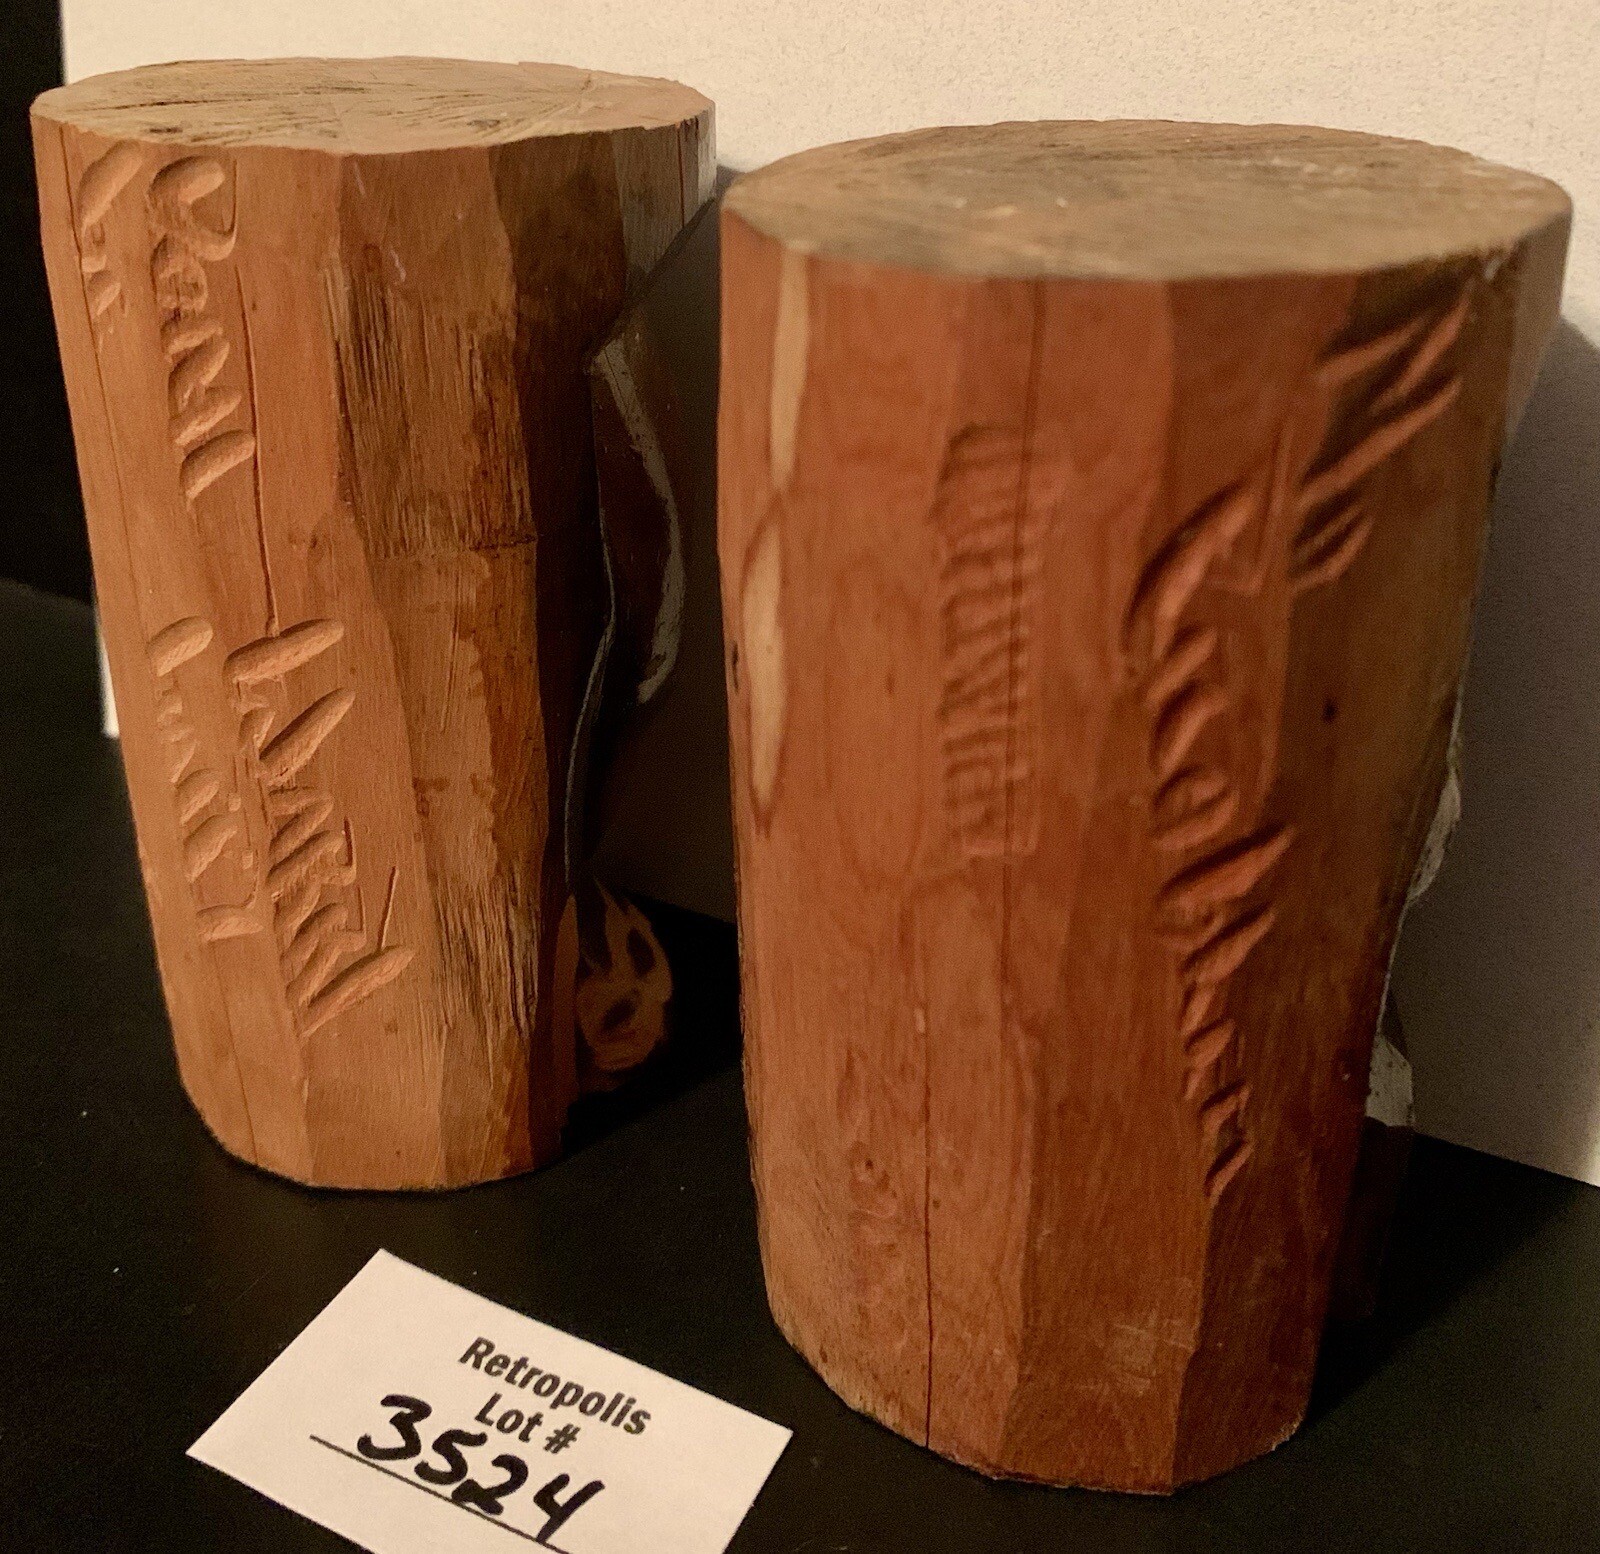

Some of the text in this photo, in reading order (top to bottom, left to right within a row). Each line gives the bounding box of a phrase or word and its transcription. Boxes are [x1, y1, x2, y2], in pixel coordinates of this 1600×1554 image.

[458, 1335, 653, 1436] Retropolis
[474, 1392, 580, 1455] Lot #
[355, 1393, 606, 1544] 3524
